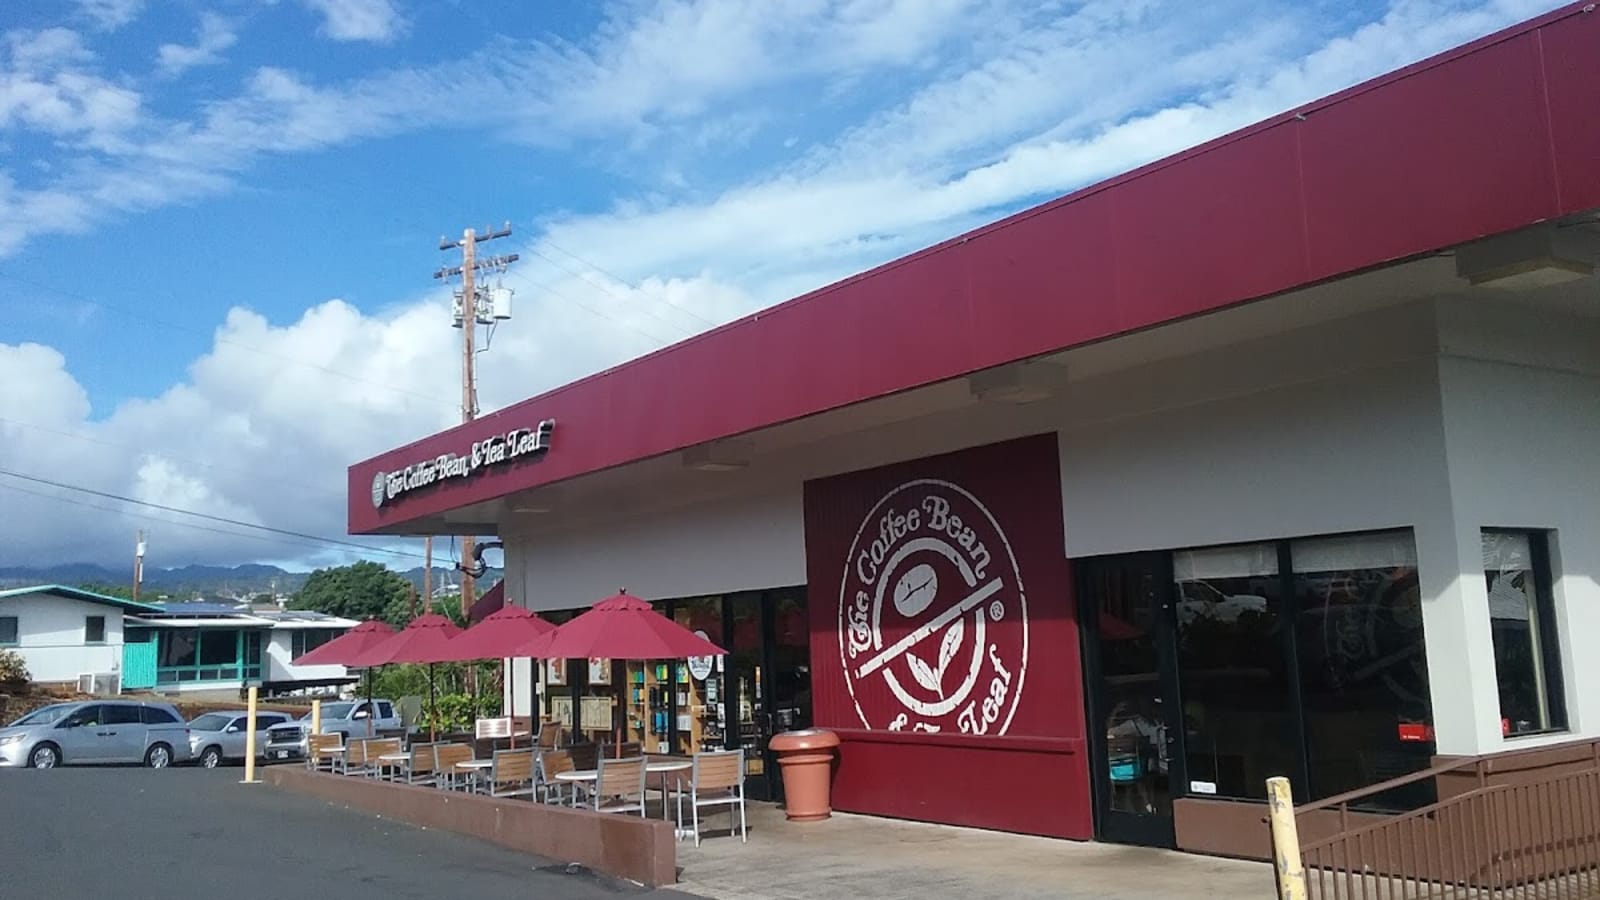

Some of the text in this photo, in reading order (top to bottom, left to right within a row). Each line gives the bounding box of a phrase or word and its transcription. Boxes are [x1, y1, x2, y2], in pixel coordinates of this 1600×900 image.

[385, 470, 404, 499] The
[403, 460, 435, 491] Coffee
[471, 442, 482, 469] &
[482, 436, 505, 466] Tea
[507, 419, 550, 458] Leaf
[847, 495, 993, 659] The Coffee Bean
[957, 643, 1011, 735] Leaf
